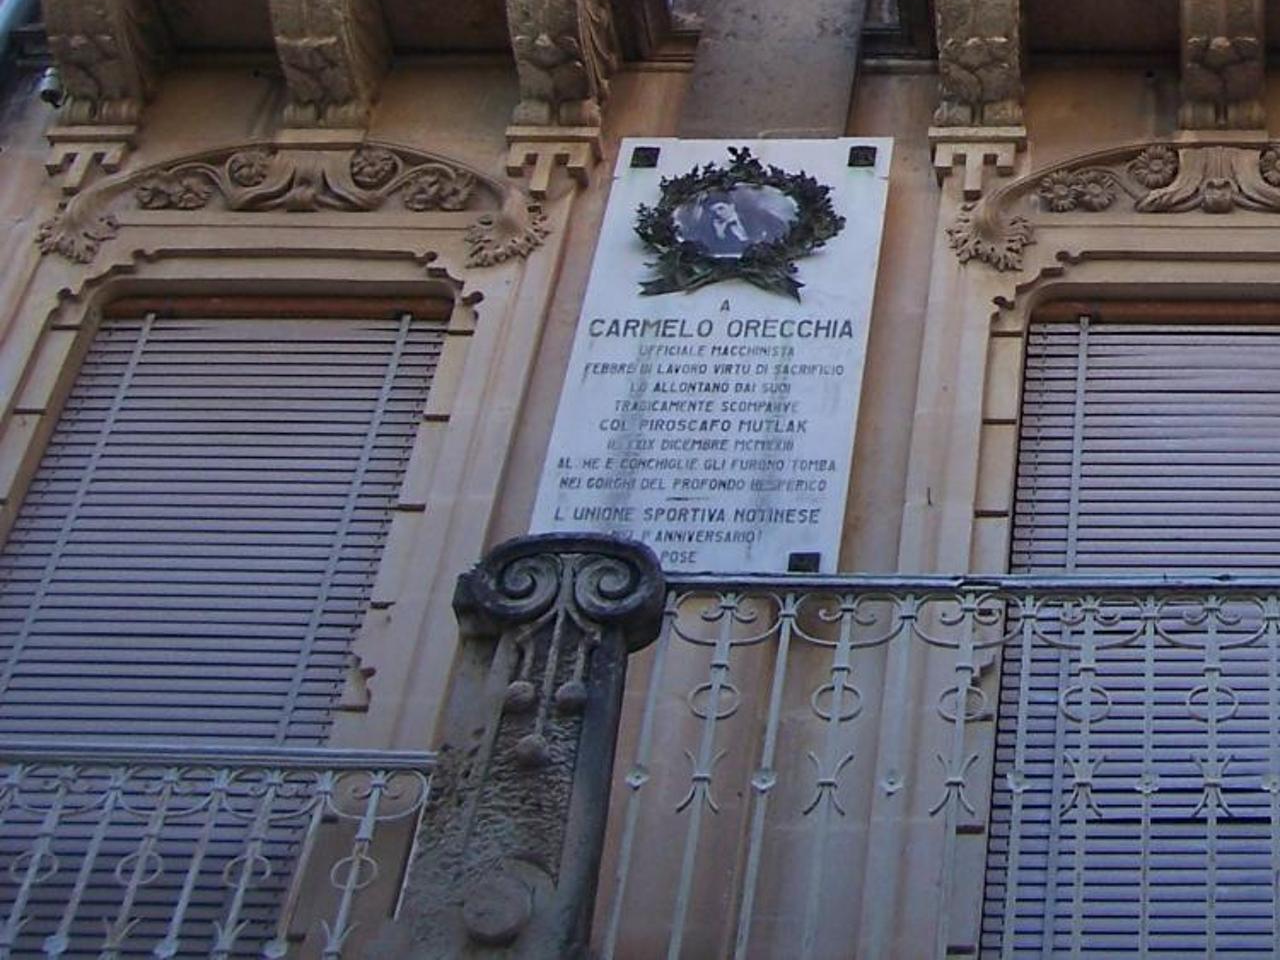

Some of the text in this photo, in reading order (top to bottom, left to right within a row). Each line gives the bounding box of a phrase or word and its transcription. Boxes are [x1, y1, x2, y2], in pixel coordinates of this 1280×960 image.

[720, 299, 730, 311] A
[588, 319, 853, 338] CARMELO ORECCHIA
[639, 345, 795, 357] UFFICIALE MACCHINISTA
[657, 363, 708, 374] LAVORO
[756, 363, 769, 375] DI
[774, 363, 845, 376] SACRIFICIO
[735, 382, 756, 393] DAI
[615, 400, 799, 413] TRAGICAMENTE SCOMPARVE
[599, 419, 629, 431] COL
[639, 419, 731, 431] PIROSCAFO
[661, 439, 728, 451] DICEMBRE
[620, 458, 698, 470] CONCHIGLIE
[704, 459, 726, 470] GLI
[731, 459, 784, 471] FURONO
[791, 459, 836, 472] TOMBA
[560, 477, 580, 489] NEI
[641, 478, 666, 490] DEL
[672, 478, 745, 490] PROFONDO
[643, 507, 726, 522] SPORTIVA
[733, 508, 821, 524] NOTINESE
[660, 550, 697, 564] POSE
